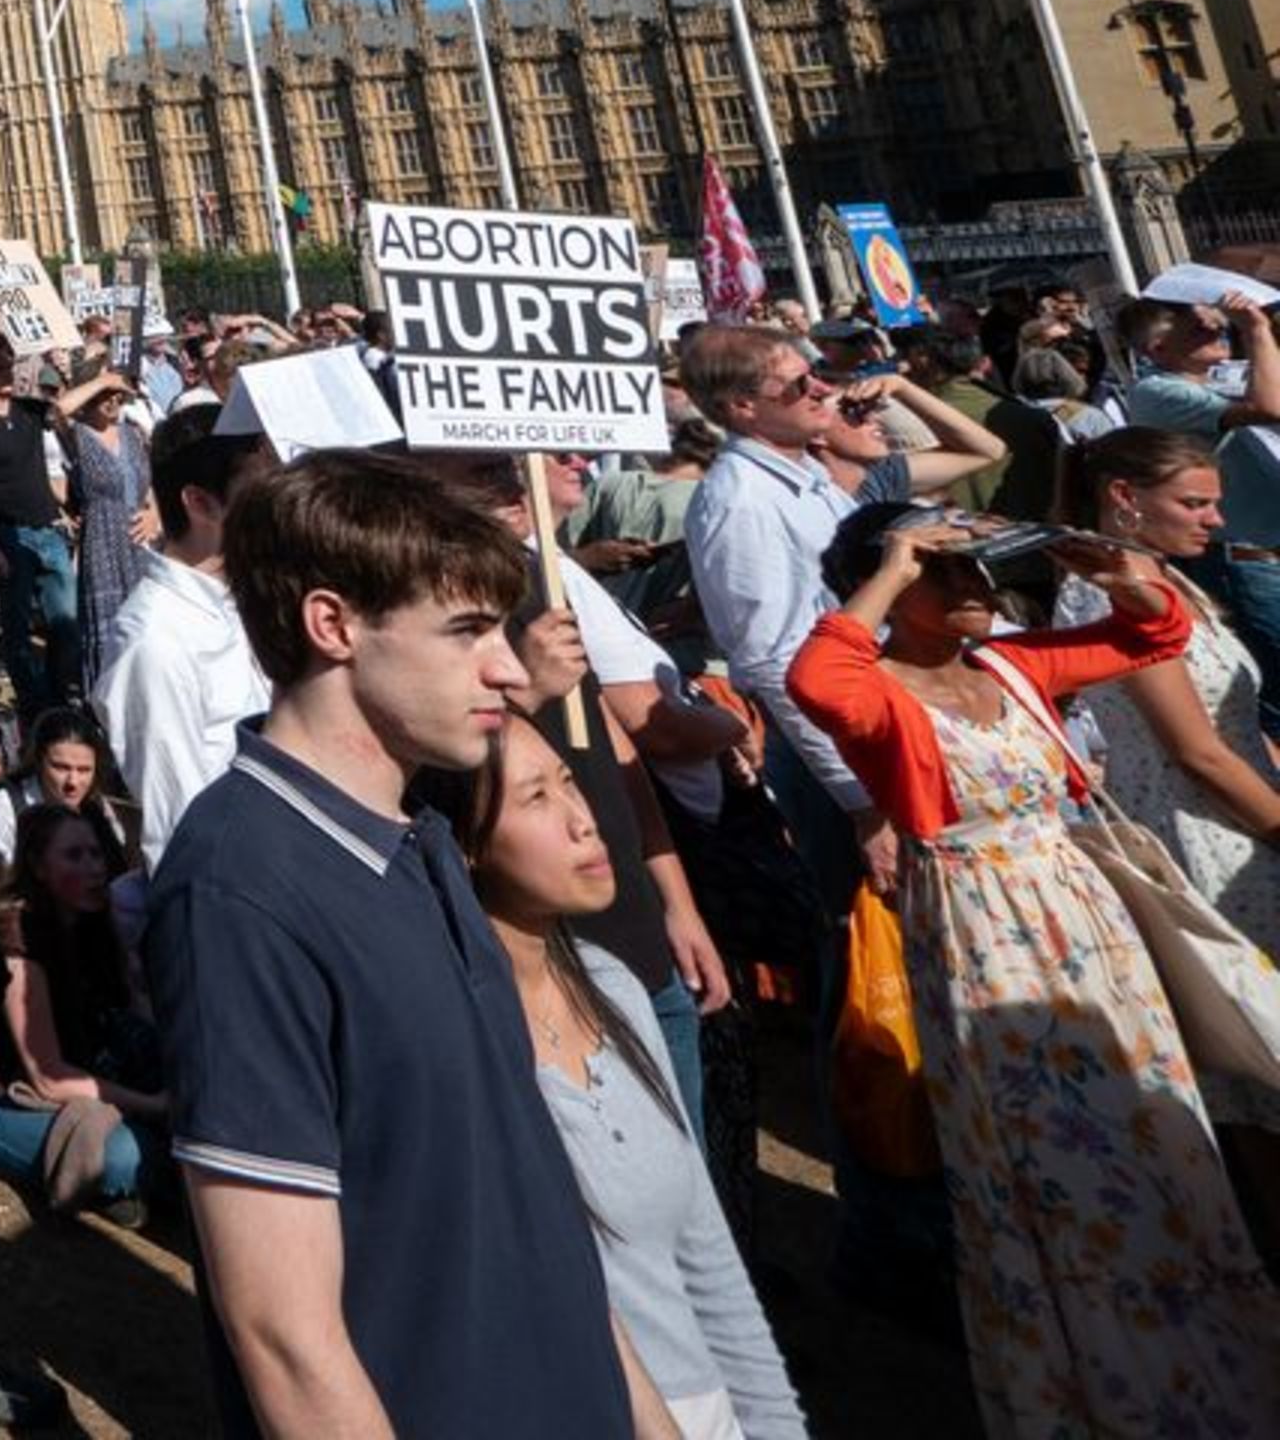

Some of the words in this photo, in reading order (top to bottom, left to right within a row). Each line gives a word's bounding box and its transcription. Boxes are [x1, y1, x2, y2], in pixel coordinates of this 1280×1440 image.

[379, 213, 638, 272] ABORTION
[385, 277, 649, 359] HURTS
[397, 362, 486, 410] THE
[497, 366, 654, 415] FAMILY
[442, 423, 510, 440] MARCH
[515, 426, 550, 442] FOR
[553, 427, 588, 443] LIFE
[592, 430, 616, 444] UK
